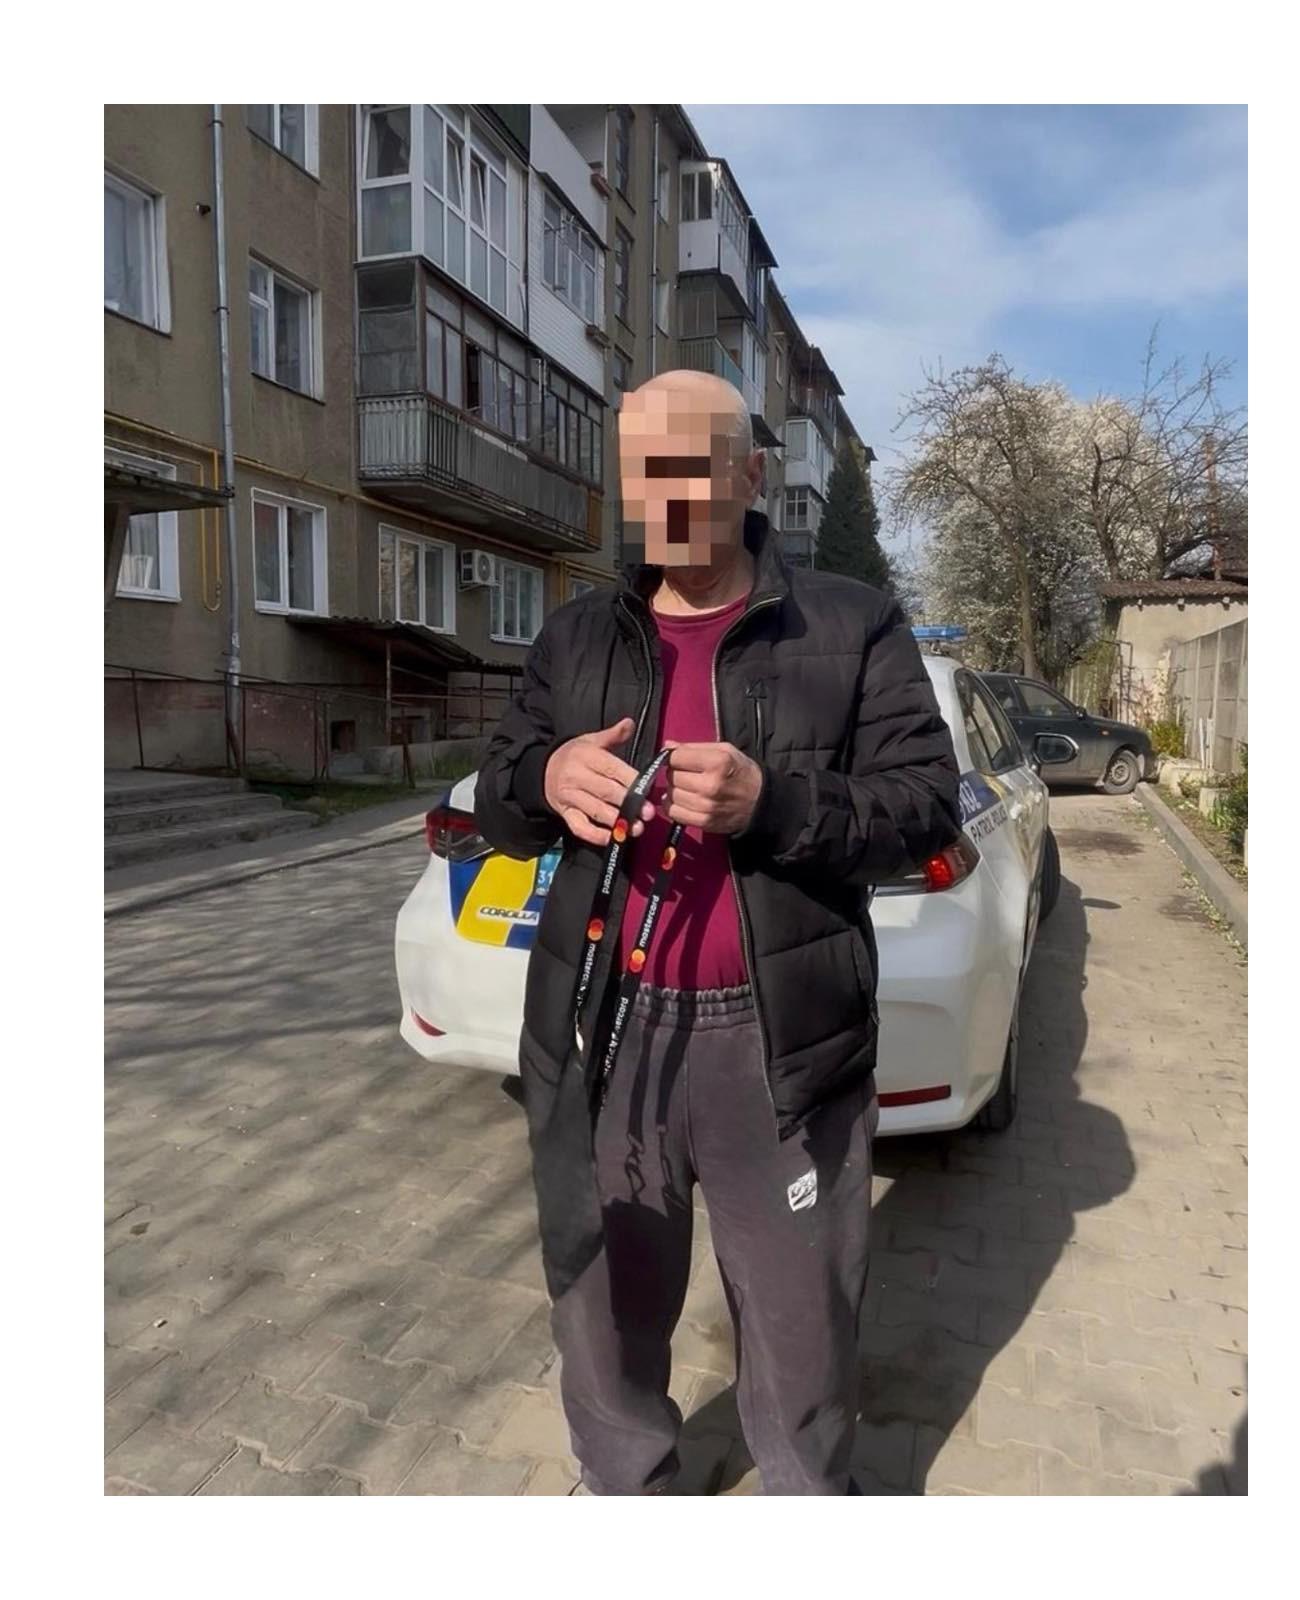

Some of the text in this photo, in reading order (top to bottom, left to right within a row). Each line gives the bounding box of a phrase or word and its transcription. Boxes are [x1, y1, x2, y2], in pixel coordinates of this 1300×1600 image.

[602, 843, 620, 895] mastercard
[480, 906, 537, 920] COROLLA
[639, 894, 660, 948] mastercard
